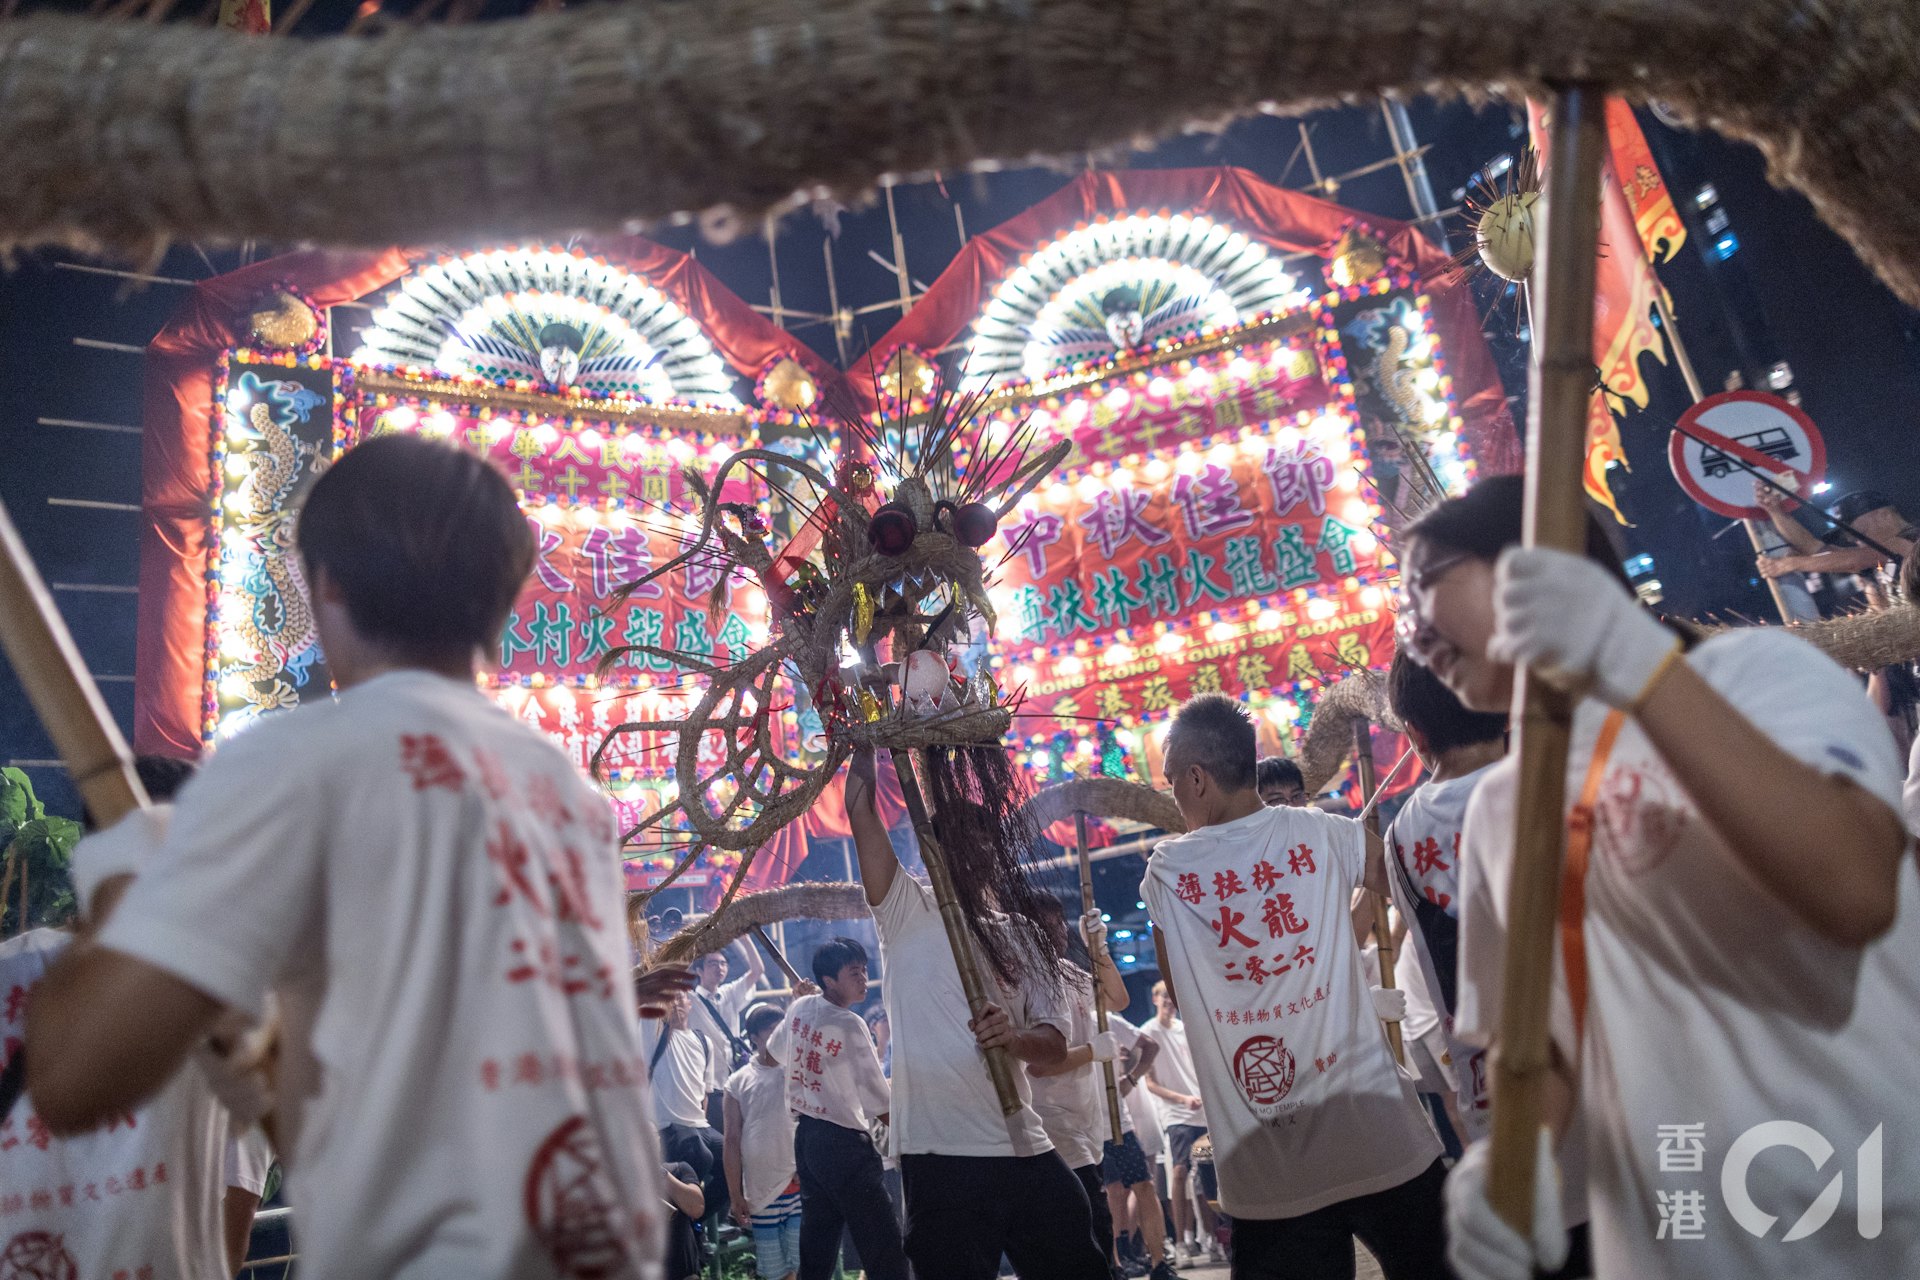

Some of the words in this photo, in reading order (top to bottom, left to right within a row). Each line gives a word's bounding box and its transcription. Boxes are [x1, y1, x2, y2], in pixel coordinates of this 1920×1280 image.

[1003, 440, 1337, 579] 中秋佳節
[1010, 514, 1360, 647] 薄扶林村火龍盛會
[1028, 675, 1086, 700] HONG
[1098, 657, 1160, 684] KONG
[1172, 629, 1284, 667] TOURISM
[1295, 608, 1379, 639] BOARD
[1175, 843, 1317, 905] 薄扶林村
[1211, 893, 1309, 948] 火龍
[1224, 945, 1316, 985] 二零二六
